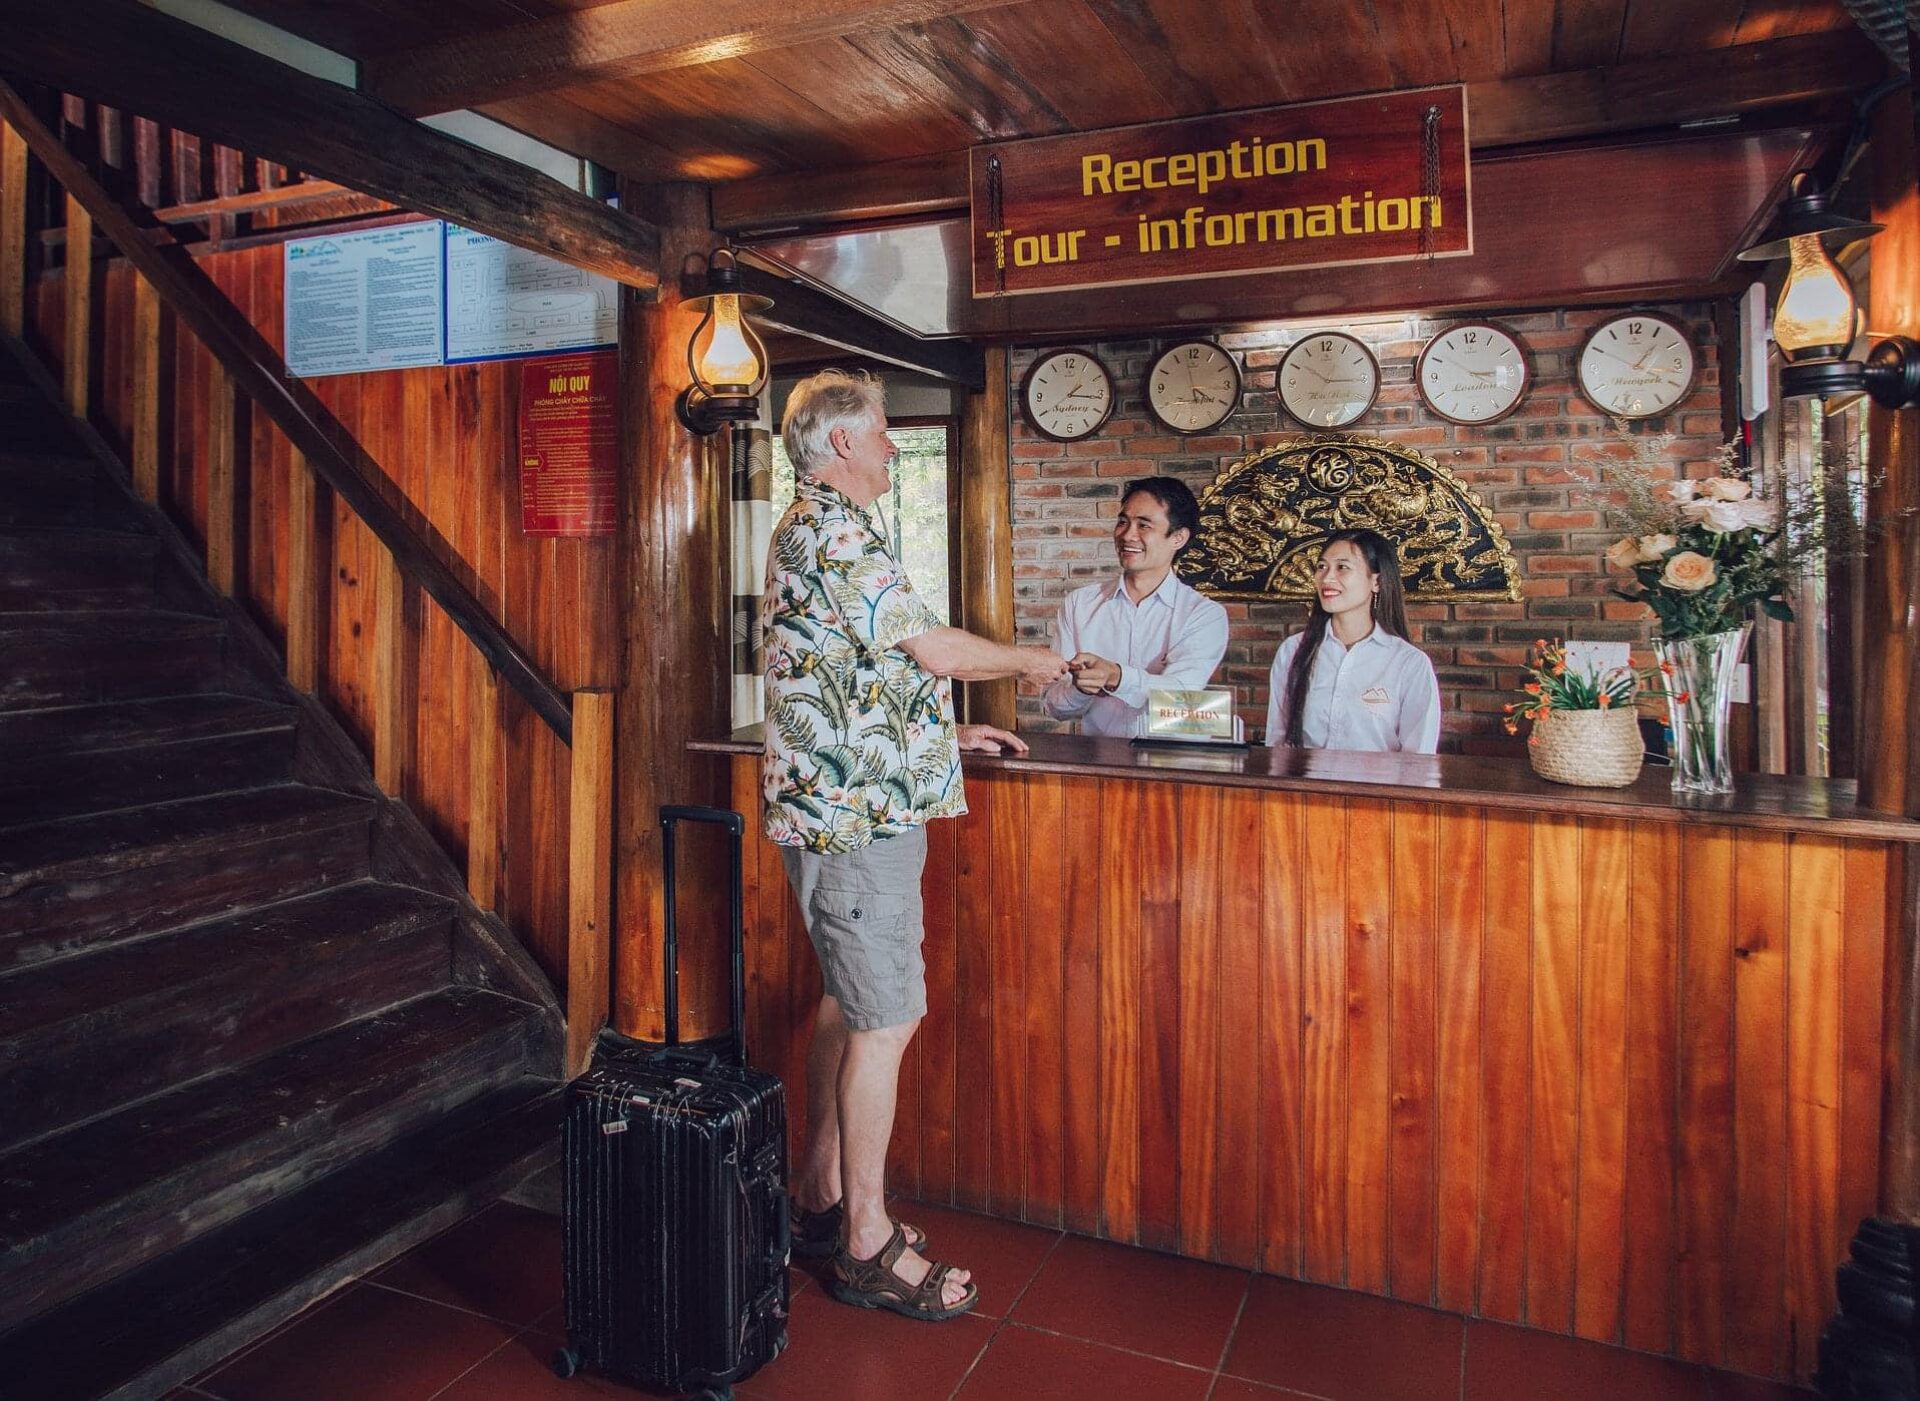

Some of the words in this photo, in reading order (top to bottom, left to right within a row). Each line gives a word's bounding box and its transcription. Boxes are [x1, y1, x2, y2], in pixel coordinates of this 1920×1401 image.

[1082, 137, 1326, 196] Reception
[986, 228, 1086, 270] Tour
[1138, 191, 1442, 253] information
[1628, 322, 1642, 335] 12
[1464, 332, 1476, 344] 12
[1320, 340, 1332, 352] 12
[1189, 348, 1199, 359] 12
[1064, 358, 1075, 369] 12
[1673, 358, 1682, 370] 3
[549, 374, 567, 396] NỘI
[570, 376, 590, 394] QUY
[1157, 384, 1165, 394] 9
[1224, 381, 1231, 390] 3
[1036, 393, 1043, 402] 9
[1053, 404, 1089, 413] Sydney
[1067, 424, 1073, 433] 6
[1160, 708, 1220, 720] RECEPTION
